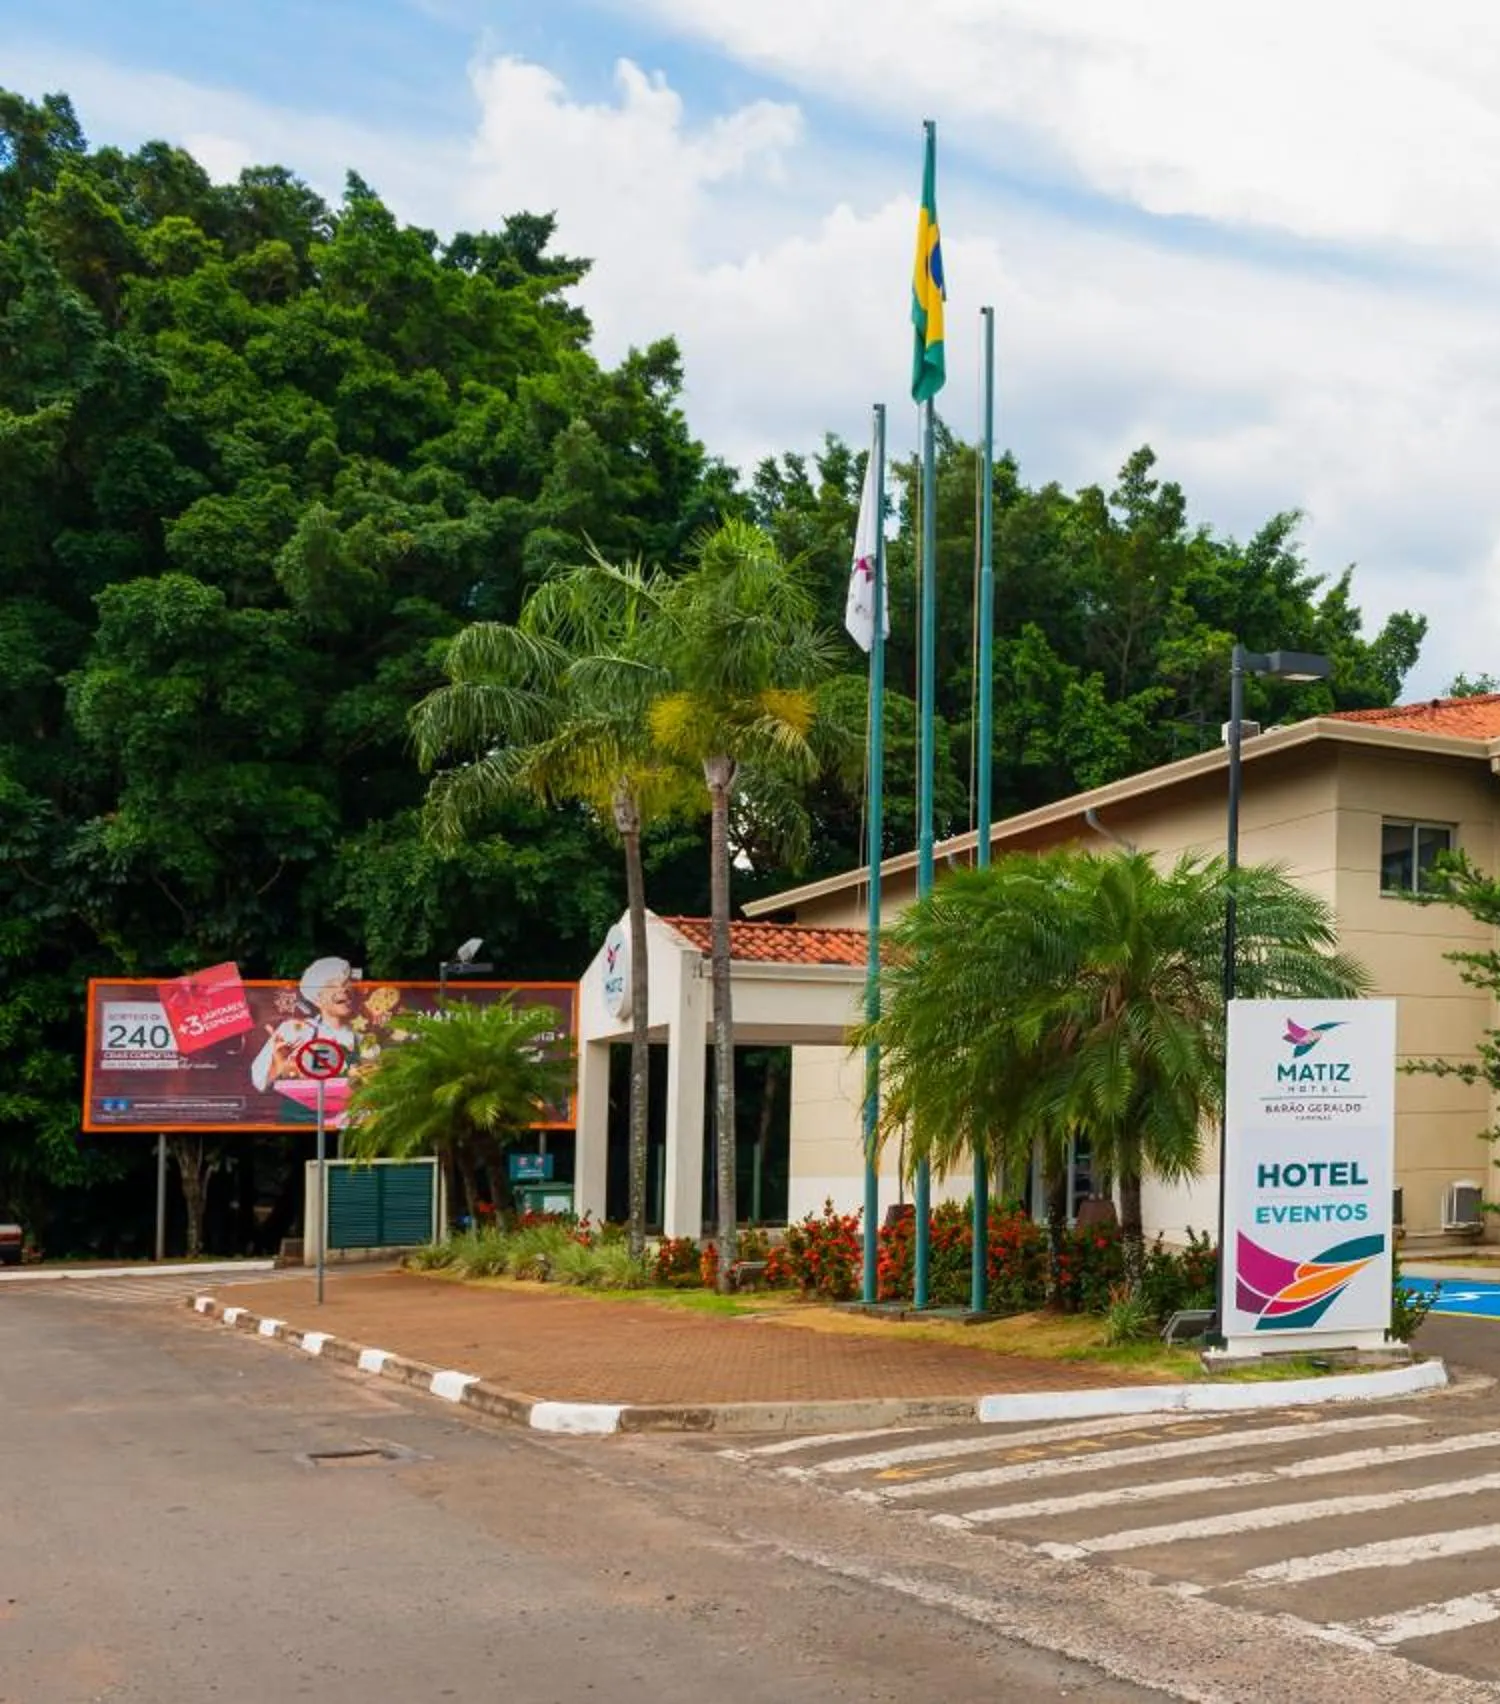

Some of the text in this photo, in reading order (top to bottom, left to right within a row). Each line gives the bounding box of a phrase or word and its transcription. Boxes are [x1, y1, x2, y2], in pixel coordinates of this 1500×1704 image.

[108, 1025, 170, 1049] 240
[313, 1049, 330, 1069] E
[1277, 1063, 1350, 1082] MATIZ
[1287, 1085, 1339, 1093] HOTEL
[1265, 1101, 1362, 1113] BARÃO GERALDO
[1257, 1162, 1369, 1189] HOTEL
[1256, 1203, 1368, 1224] EVENTOS
